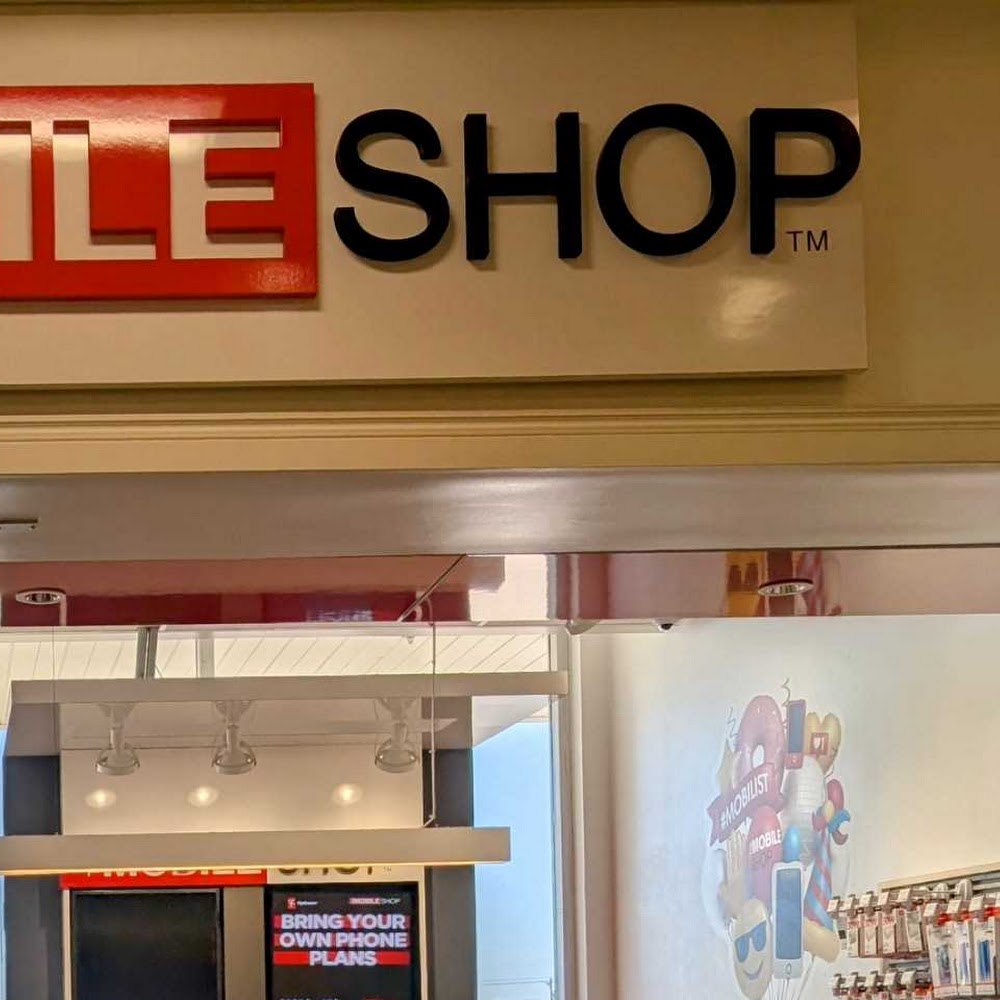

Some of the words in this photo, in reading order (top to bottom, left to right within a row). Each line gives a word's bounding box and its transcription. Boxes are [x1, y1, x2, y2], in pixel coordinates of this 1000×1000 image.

[333, 103, 861, 263] SHOP
[786, 229, 829, 253] TM
[720, 772, 769, 830] #MOBILIST
[281, 913, 344, 930] BRING
[345, 913, 406, 930] YOUR
[279, 931, 331, 948] OWN
[335, 931, 408, 948] PHONE
[308, 950, 378, 966] PLANS
